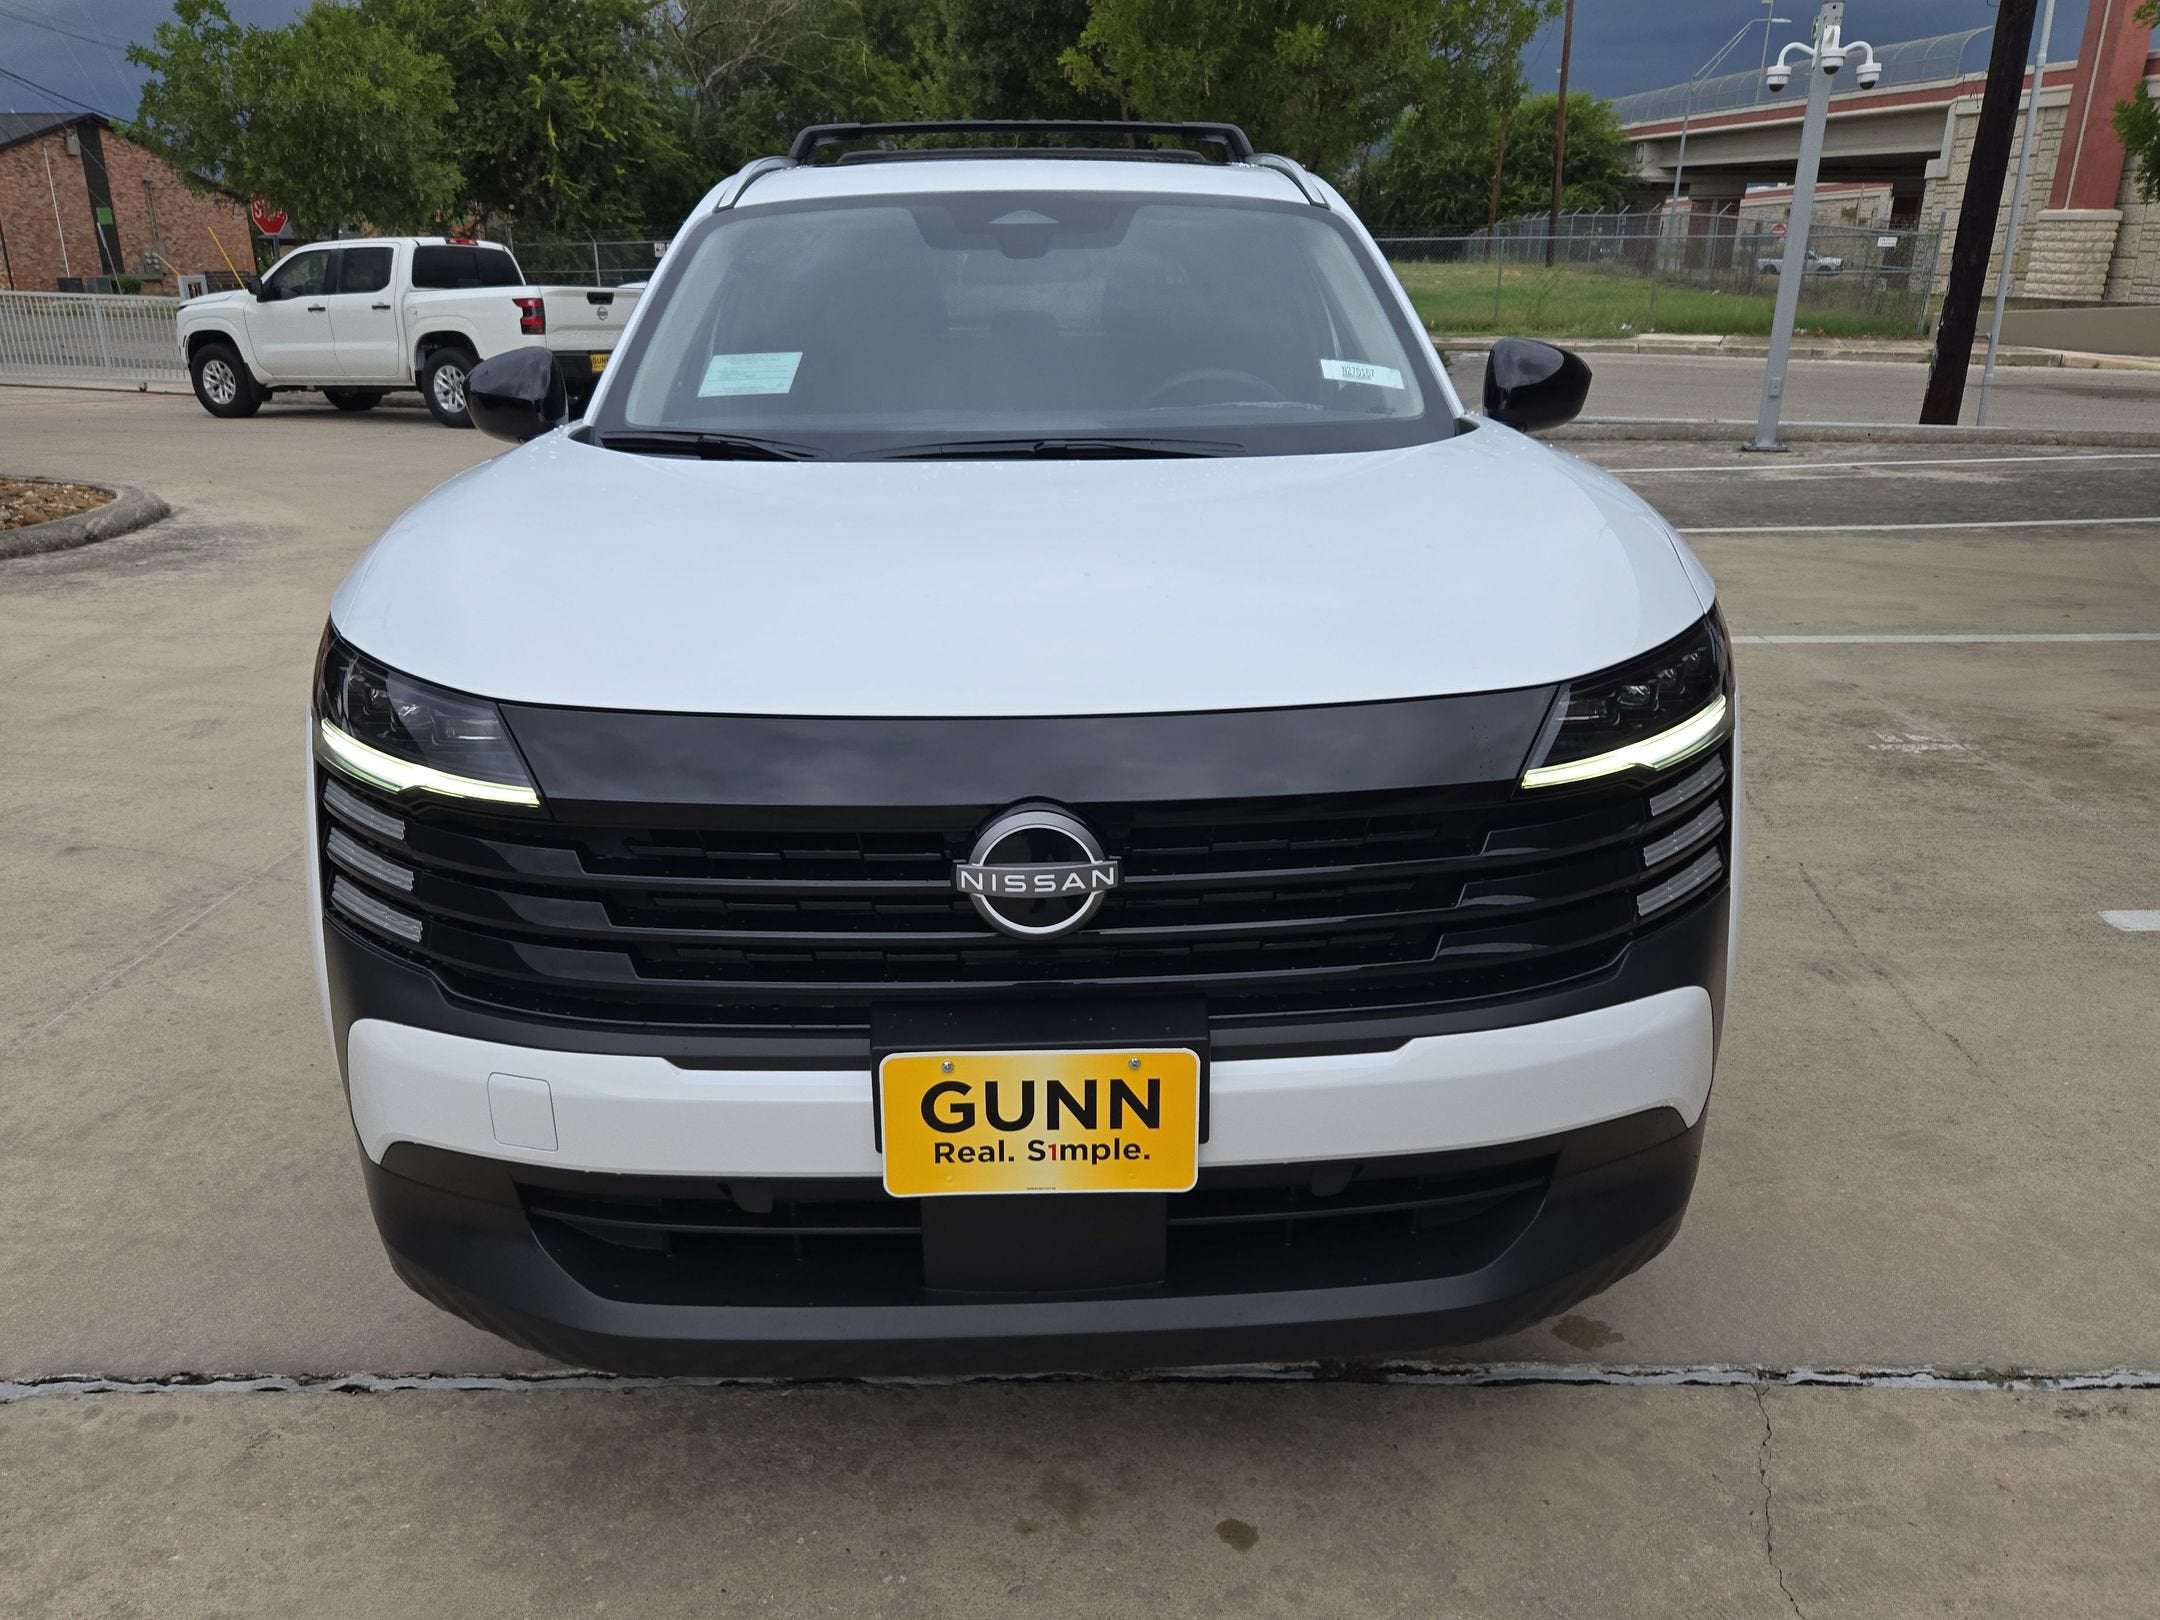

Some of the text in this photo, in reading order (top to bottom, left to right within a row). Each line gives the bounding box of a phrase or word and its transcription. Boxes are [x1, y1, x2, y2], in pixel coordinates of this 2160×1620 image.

[961, 867, 1114, 892] NISSAN
[921, 1079, 1161, 1133] GUNN
[934, 1138, 1150, 1165] Real. S1mple.
